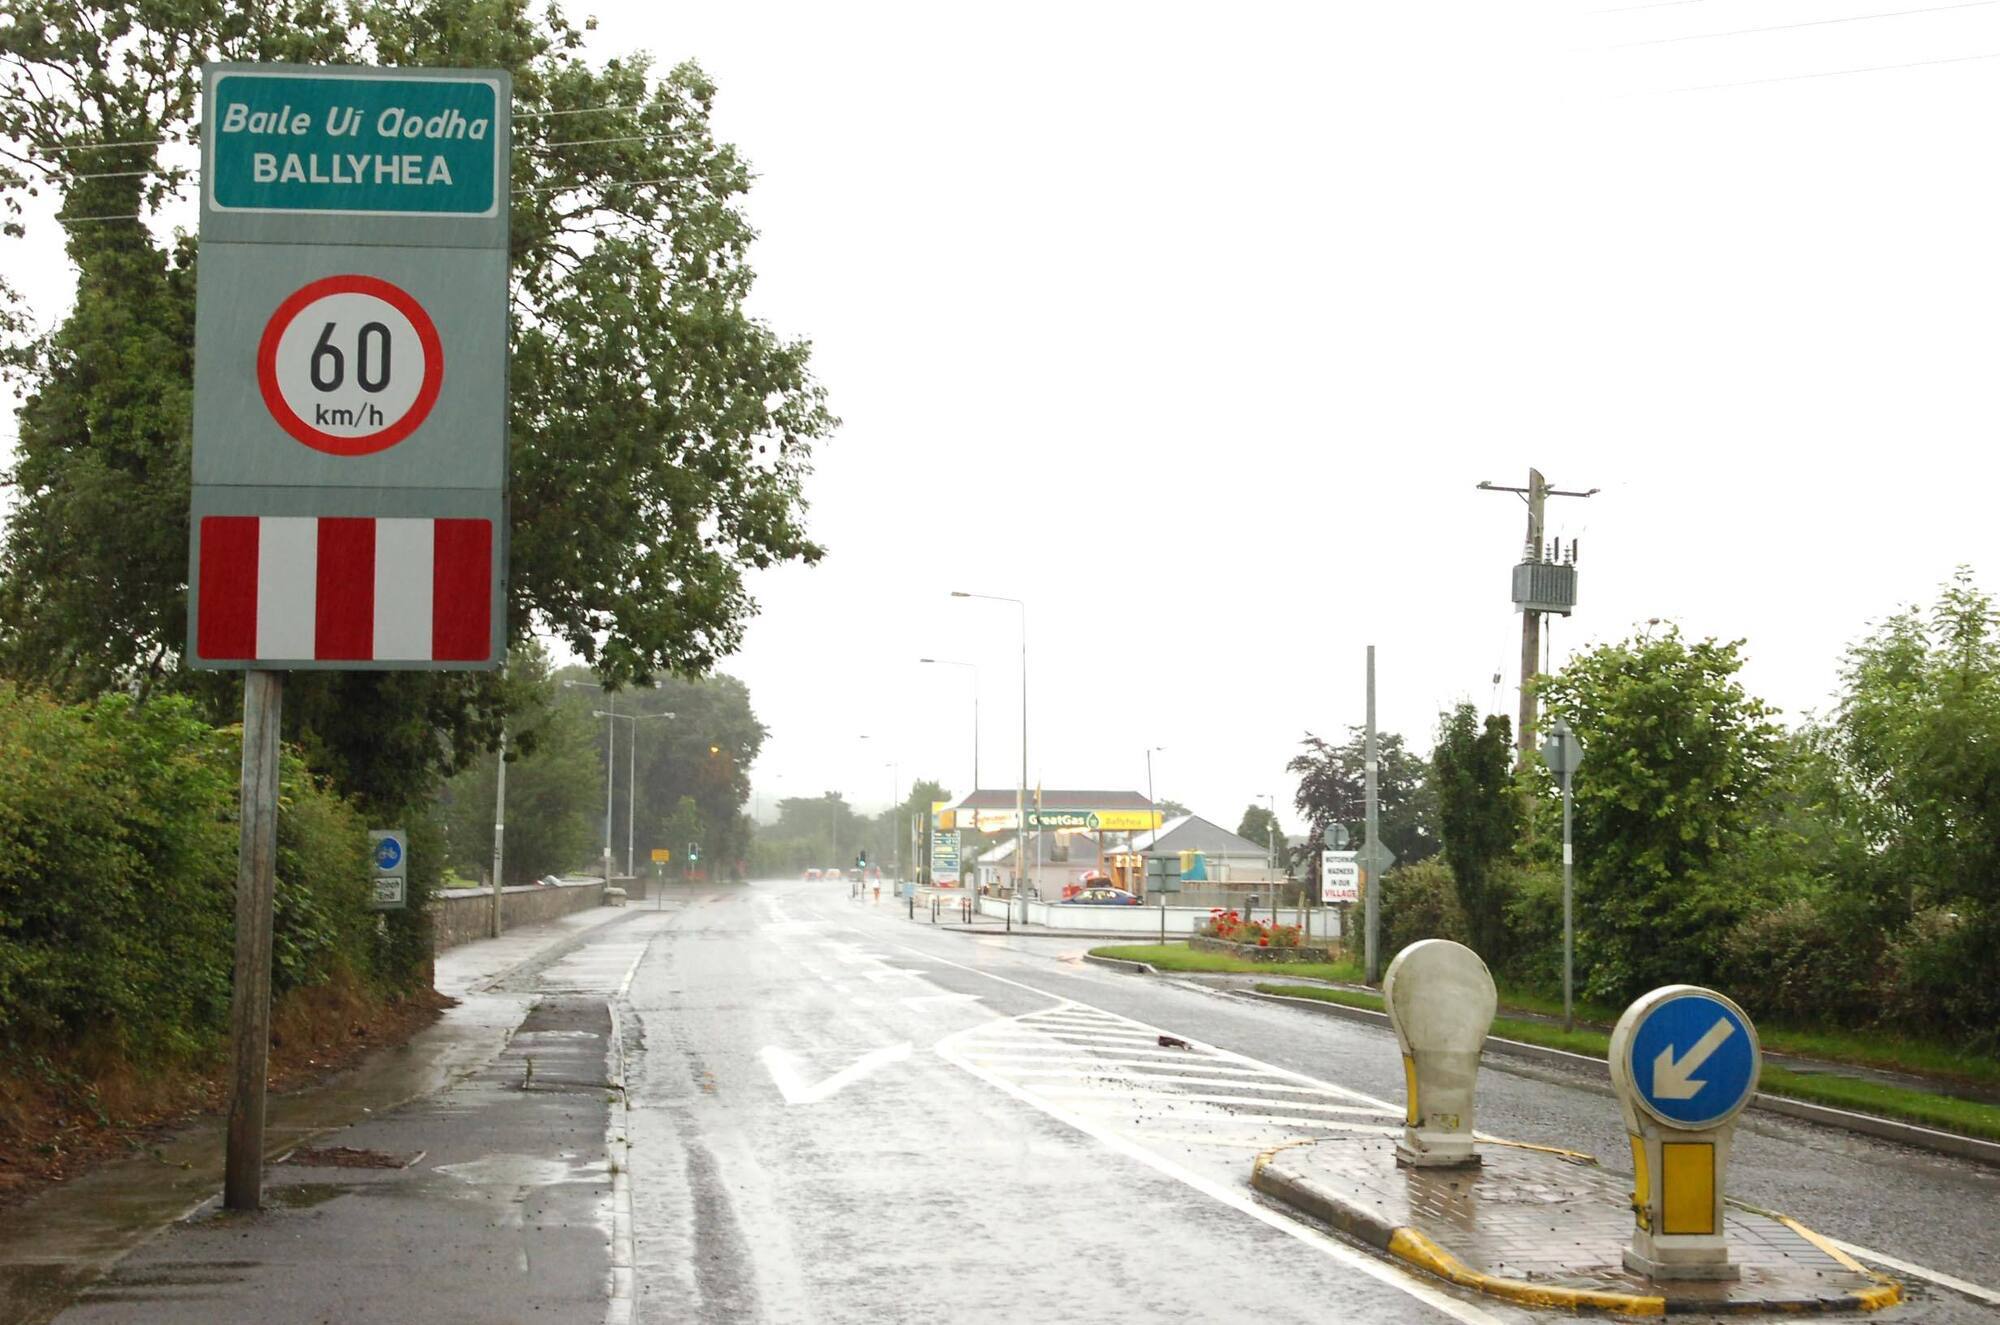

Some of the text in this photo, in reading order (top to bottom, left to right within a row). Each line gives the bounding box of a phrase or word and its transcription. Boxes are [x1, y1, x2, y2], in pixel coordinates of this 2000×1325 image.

[326, 106, 364, 137] Uí
[253, 153, 453, 185] BALLYHEA
[310, 321, 392, 394] 60
[315, 402, 384, 428] km/h
[1028, 814, 1085, 826] GreatGas
[1325, 889, 1356, 897] VILLAGE
